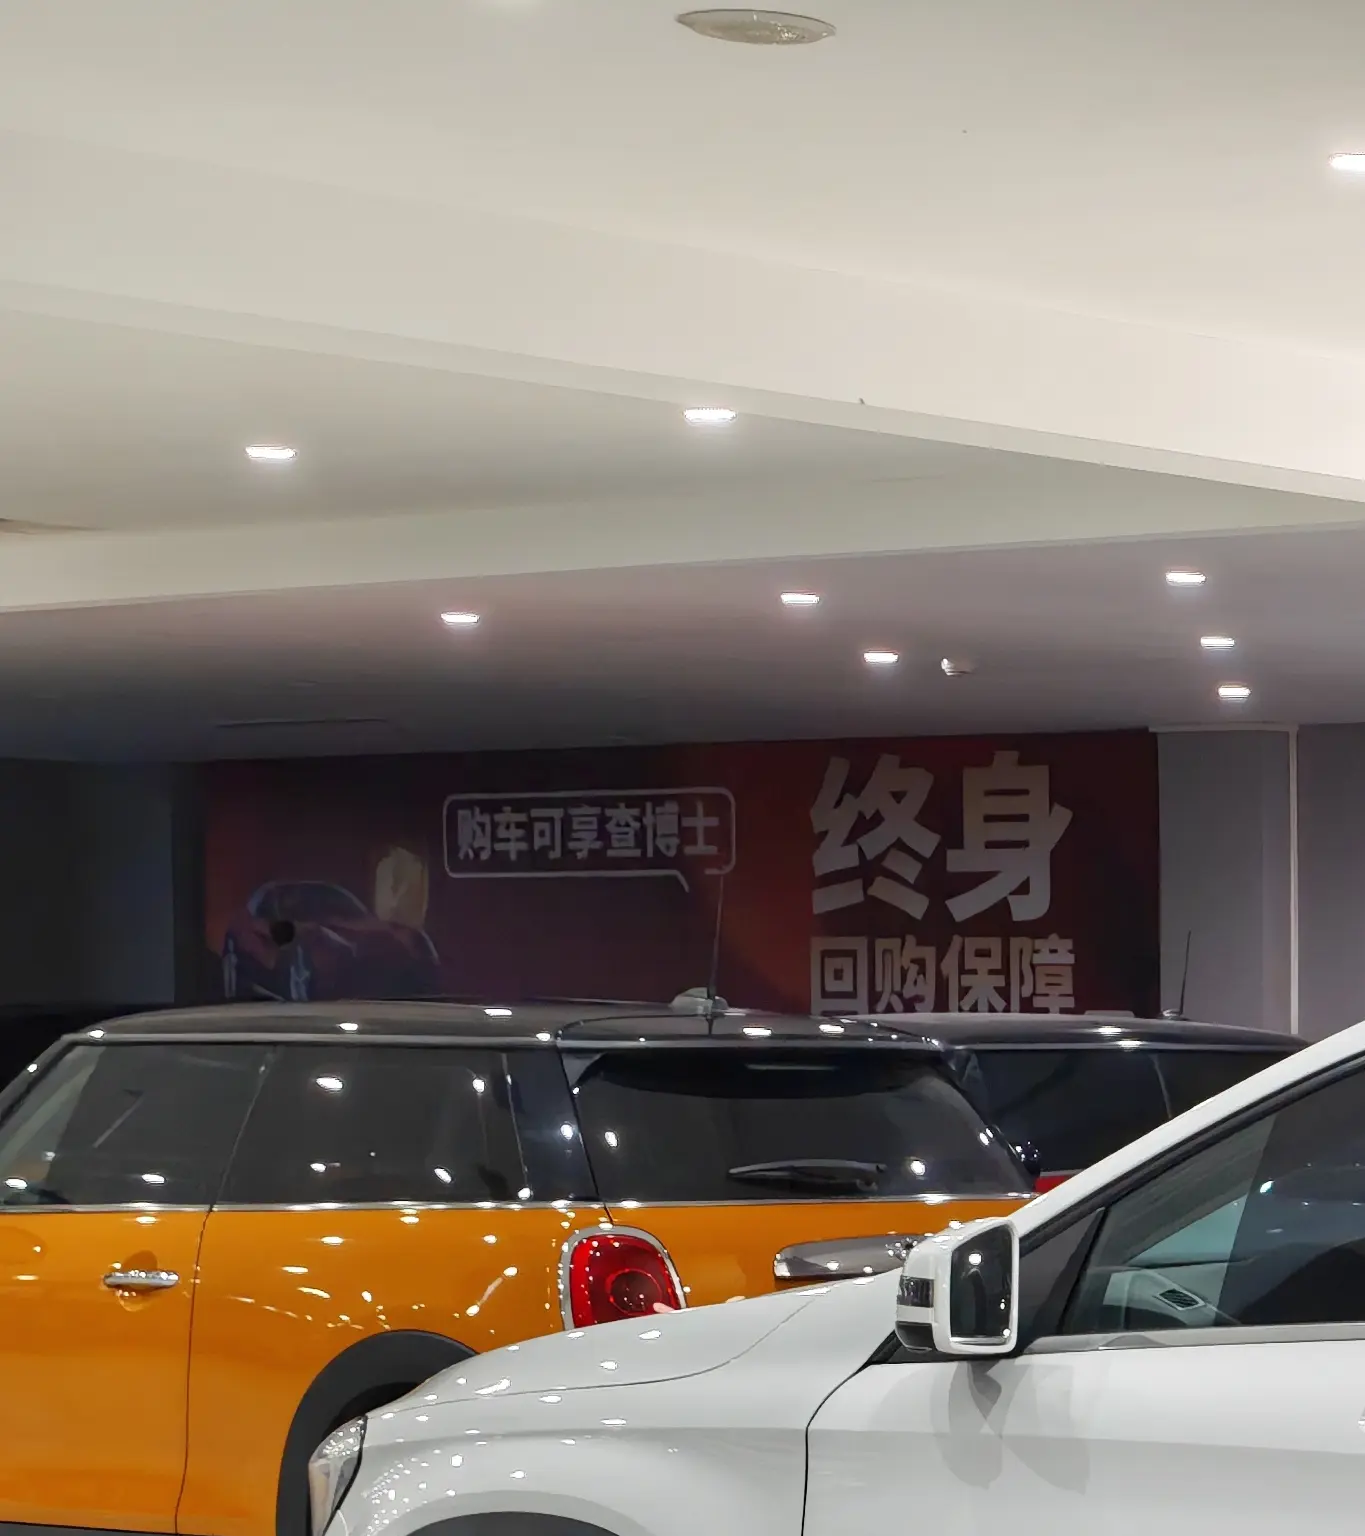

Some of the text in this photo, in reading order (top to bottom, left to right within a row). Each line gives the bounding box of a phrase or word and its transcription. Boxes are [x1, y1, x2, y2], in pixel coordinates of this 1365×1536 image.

[456, 801, 721, 861] 购车可享查博士
[809, 750, 1073, 922] 终身
[810, 932, 1076, 1015] 回购保障
